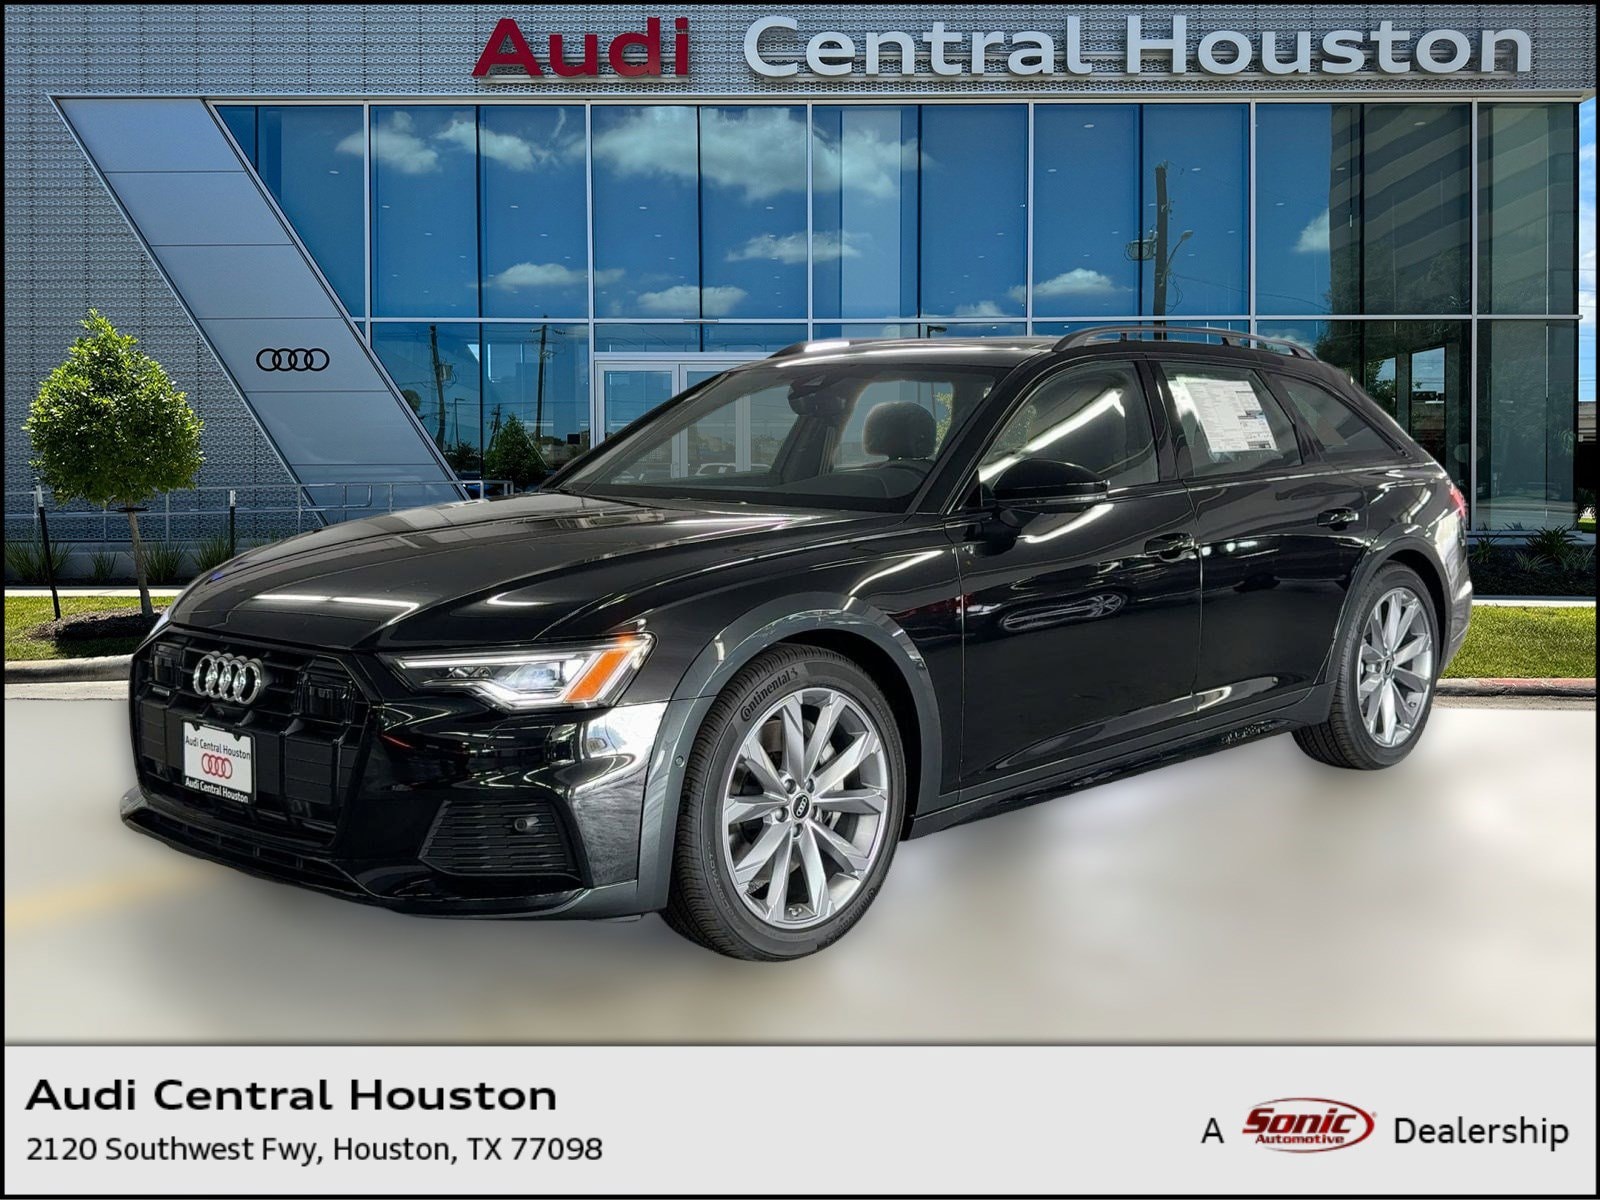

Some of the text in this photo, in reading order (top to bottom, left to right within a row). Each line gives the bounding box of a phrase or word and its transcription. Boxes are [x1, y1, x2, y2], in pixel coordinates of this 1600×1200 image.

[472, 15, 1532, 77] Audi Central Houston
[741, 670, 791, 722] Continental
[185, 736, 250, 759] Audi Central Houston
[185, 777, 249, 803] Audi Central Houston
